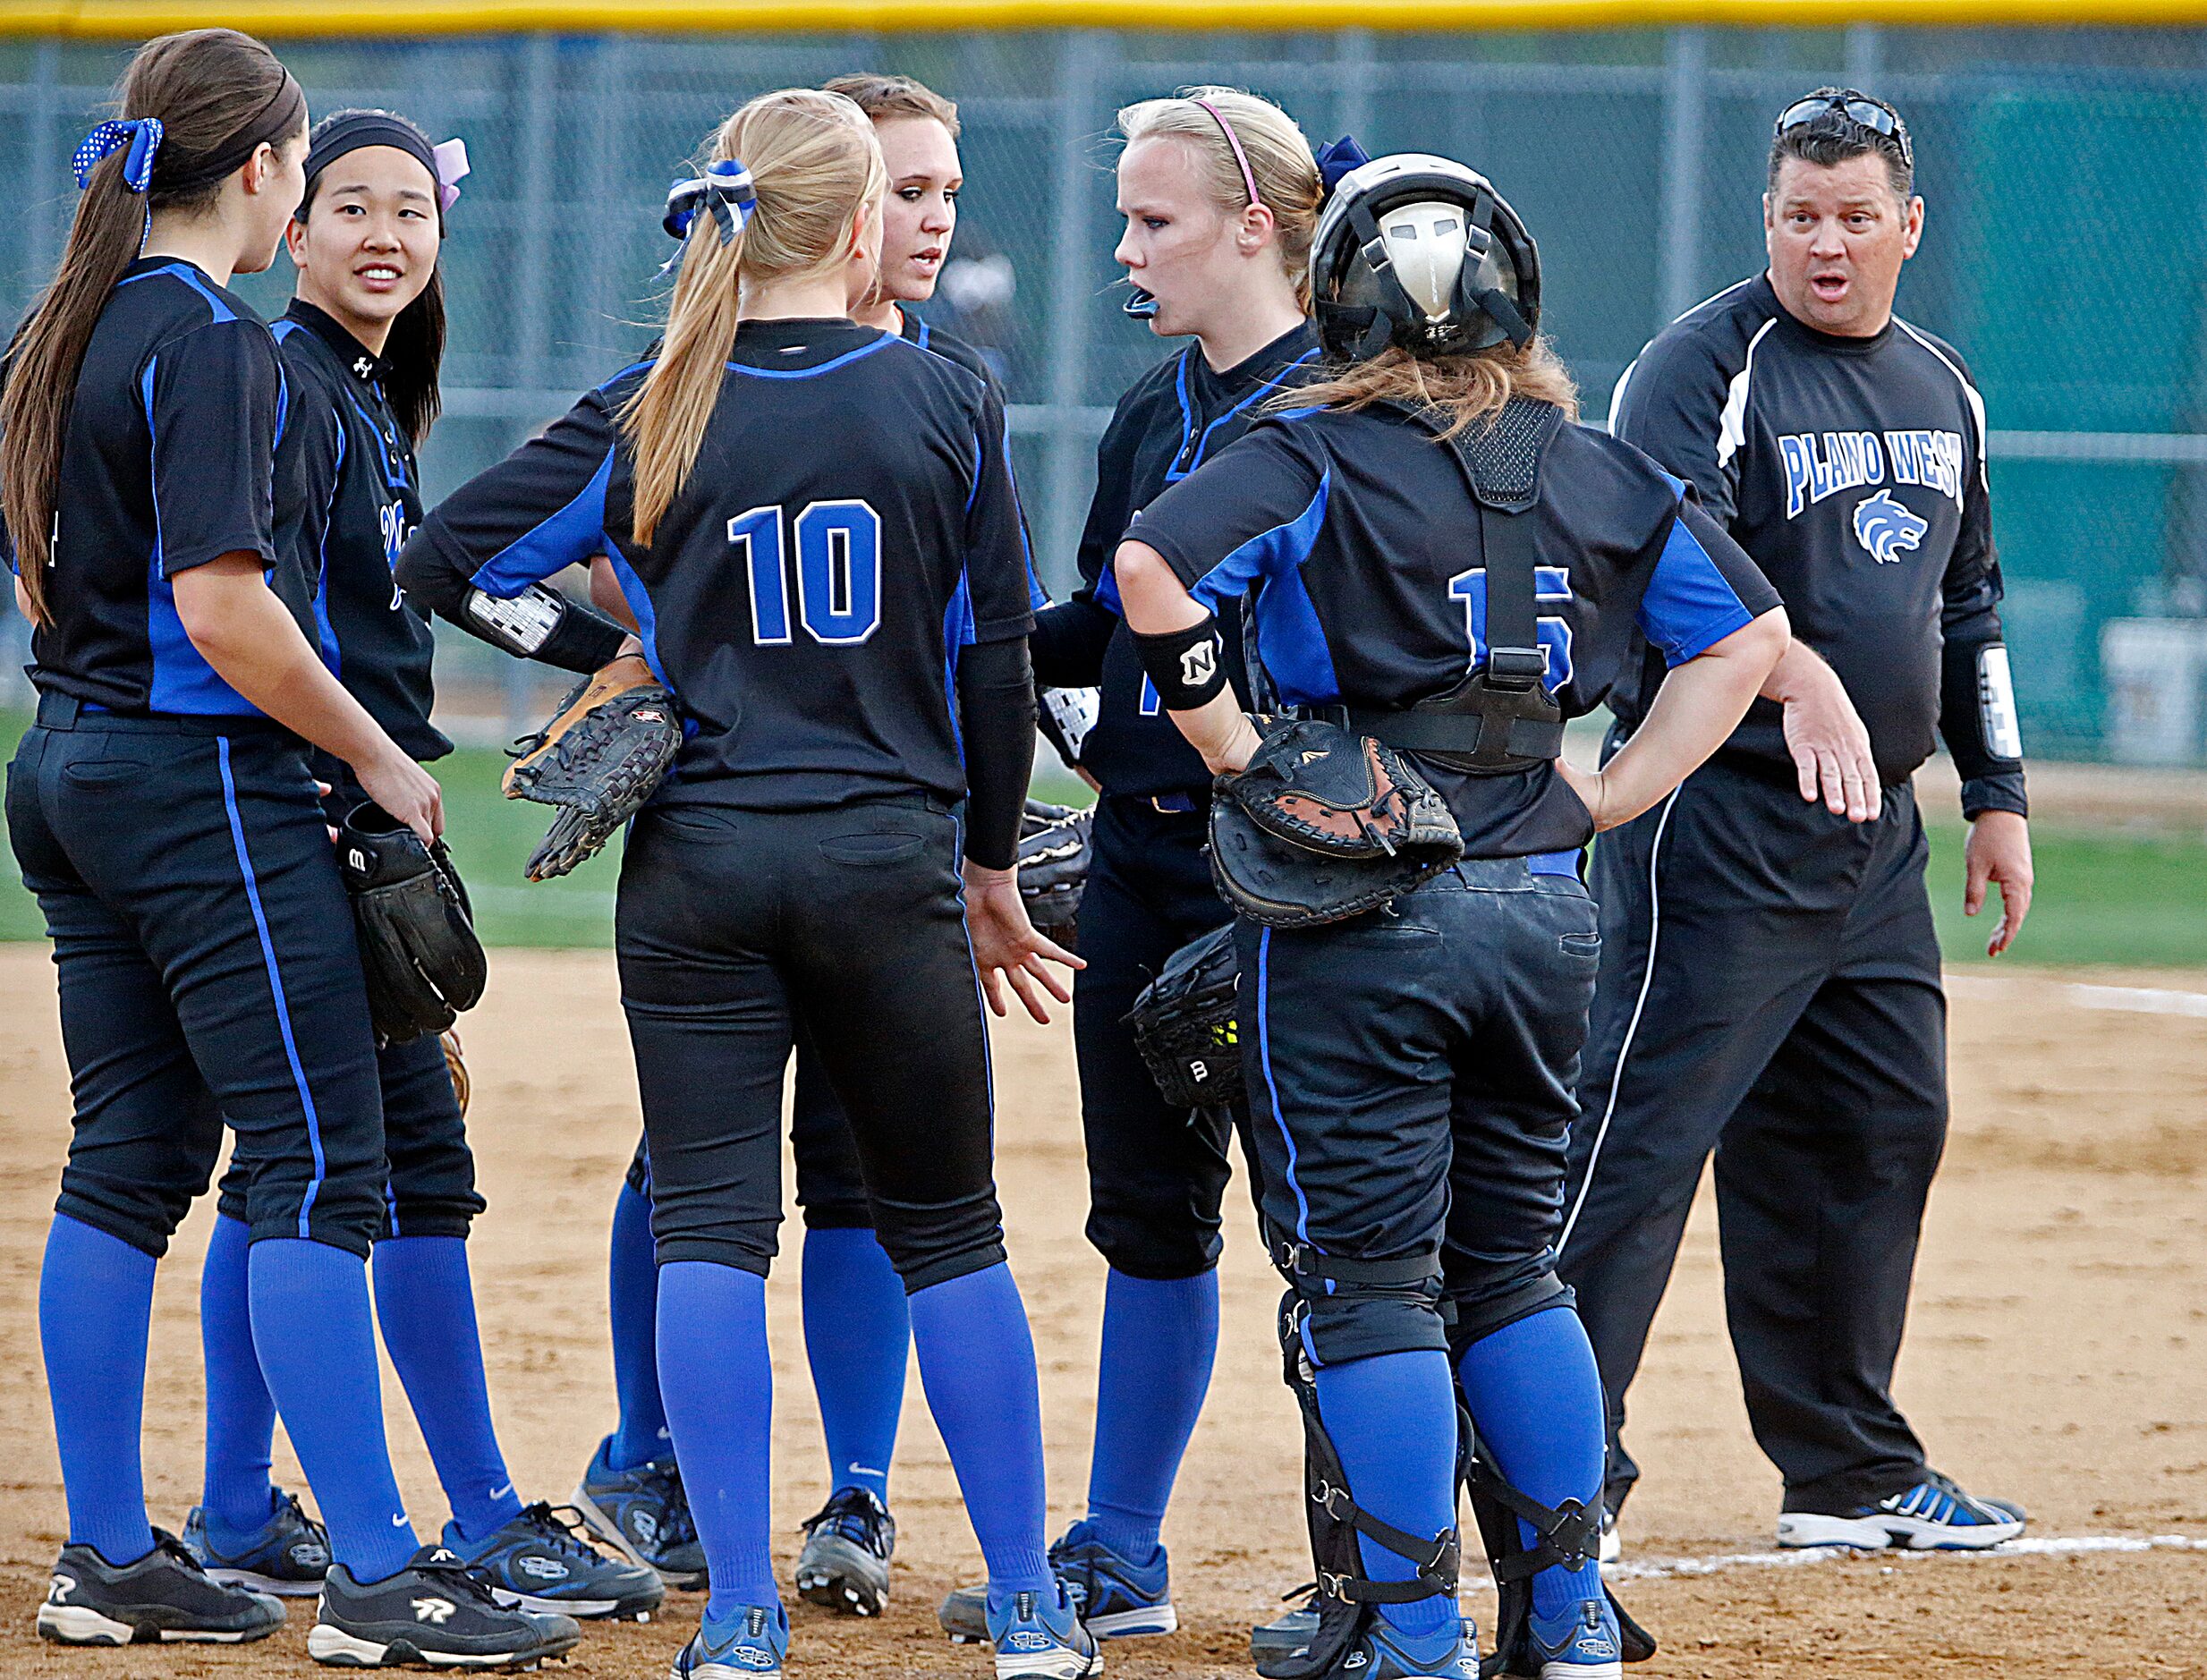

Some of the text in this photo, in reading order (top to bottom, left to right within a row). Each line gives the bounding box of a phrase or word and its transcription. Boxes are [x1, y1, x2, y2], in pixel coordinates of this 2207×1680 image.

[1778, 430, 1964, 520] PLANO WEST
[727, 499, 882, 646] 10
[1184, 642, 1214, 682] N
